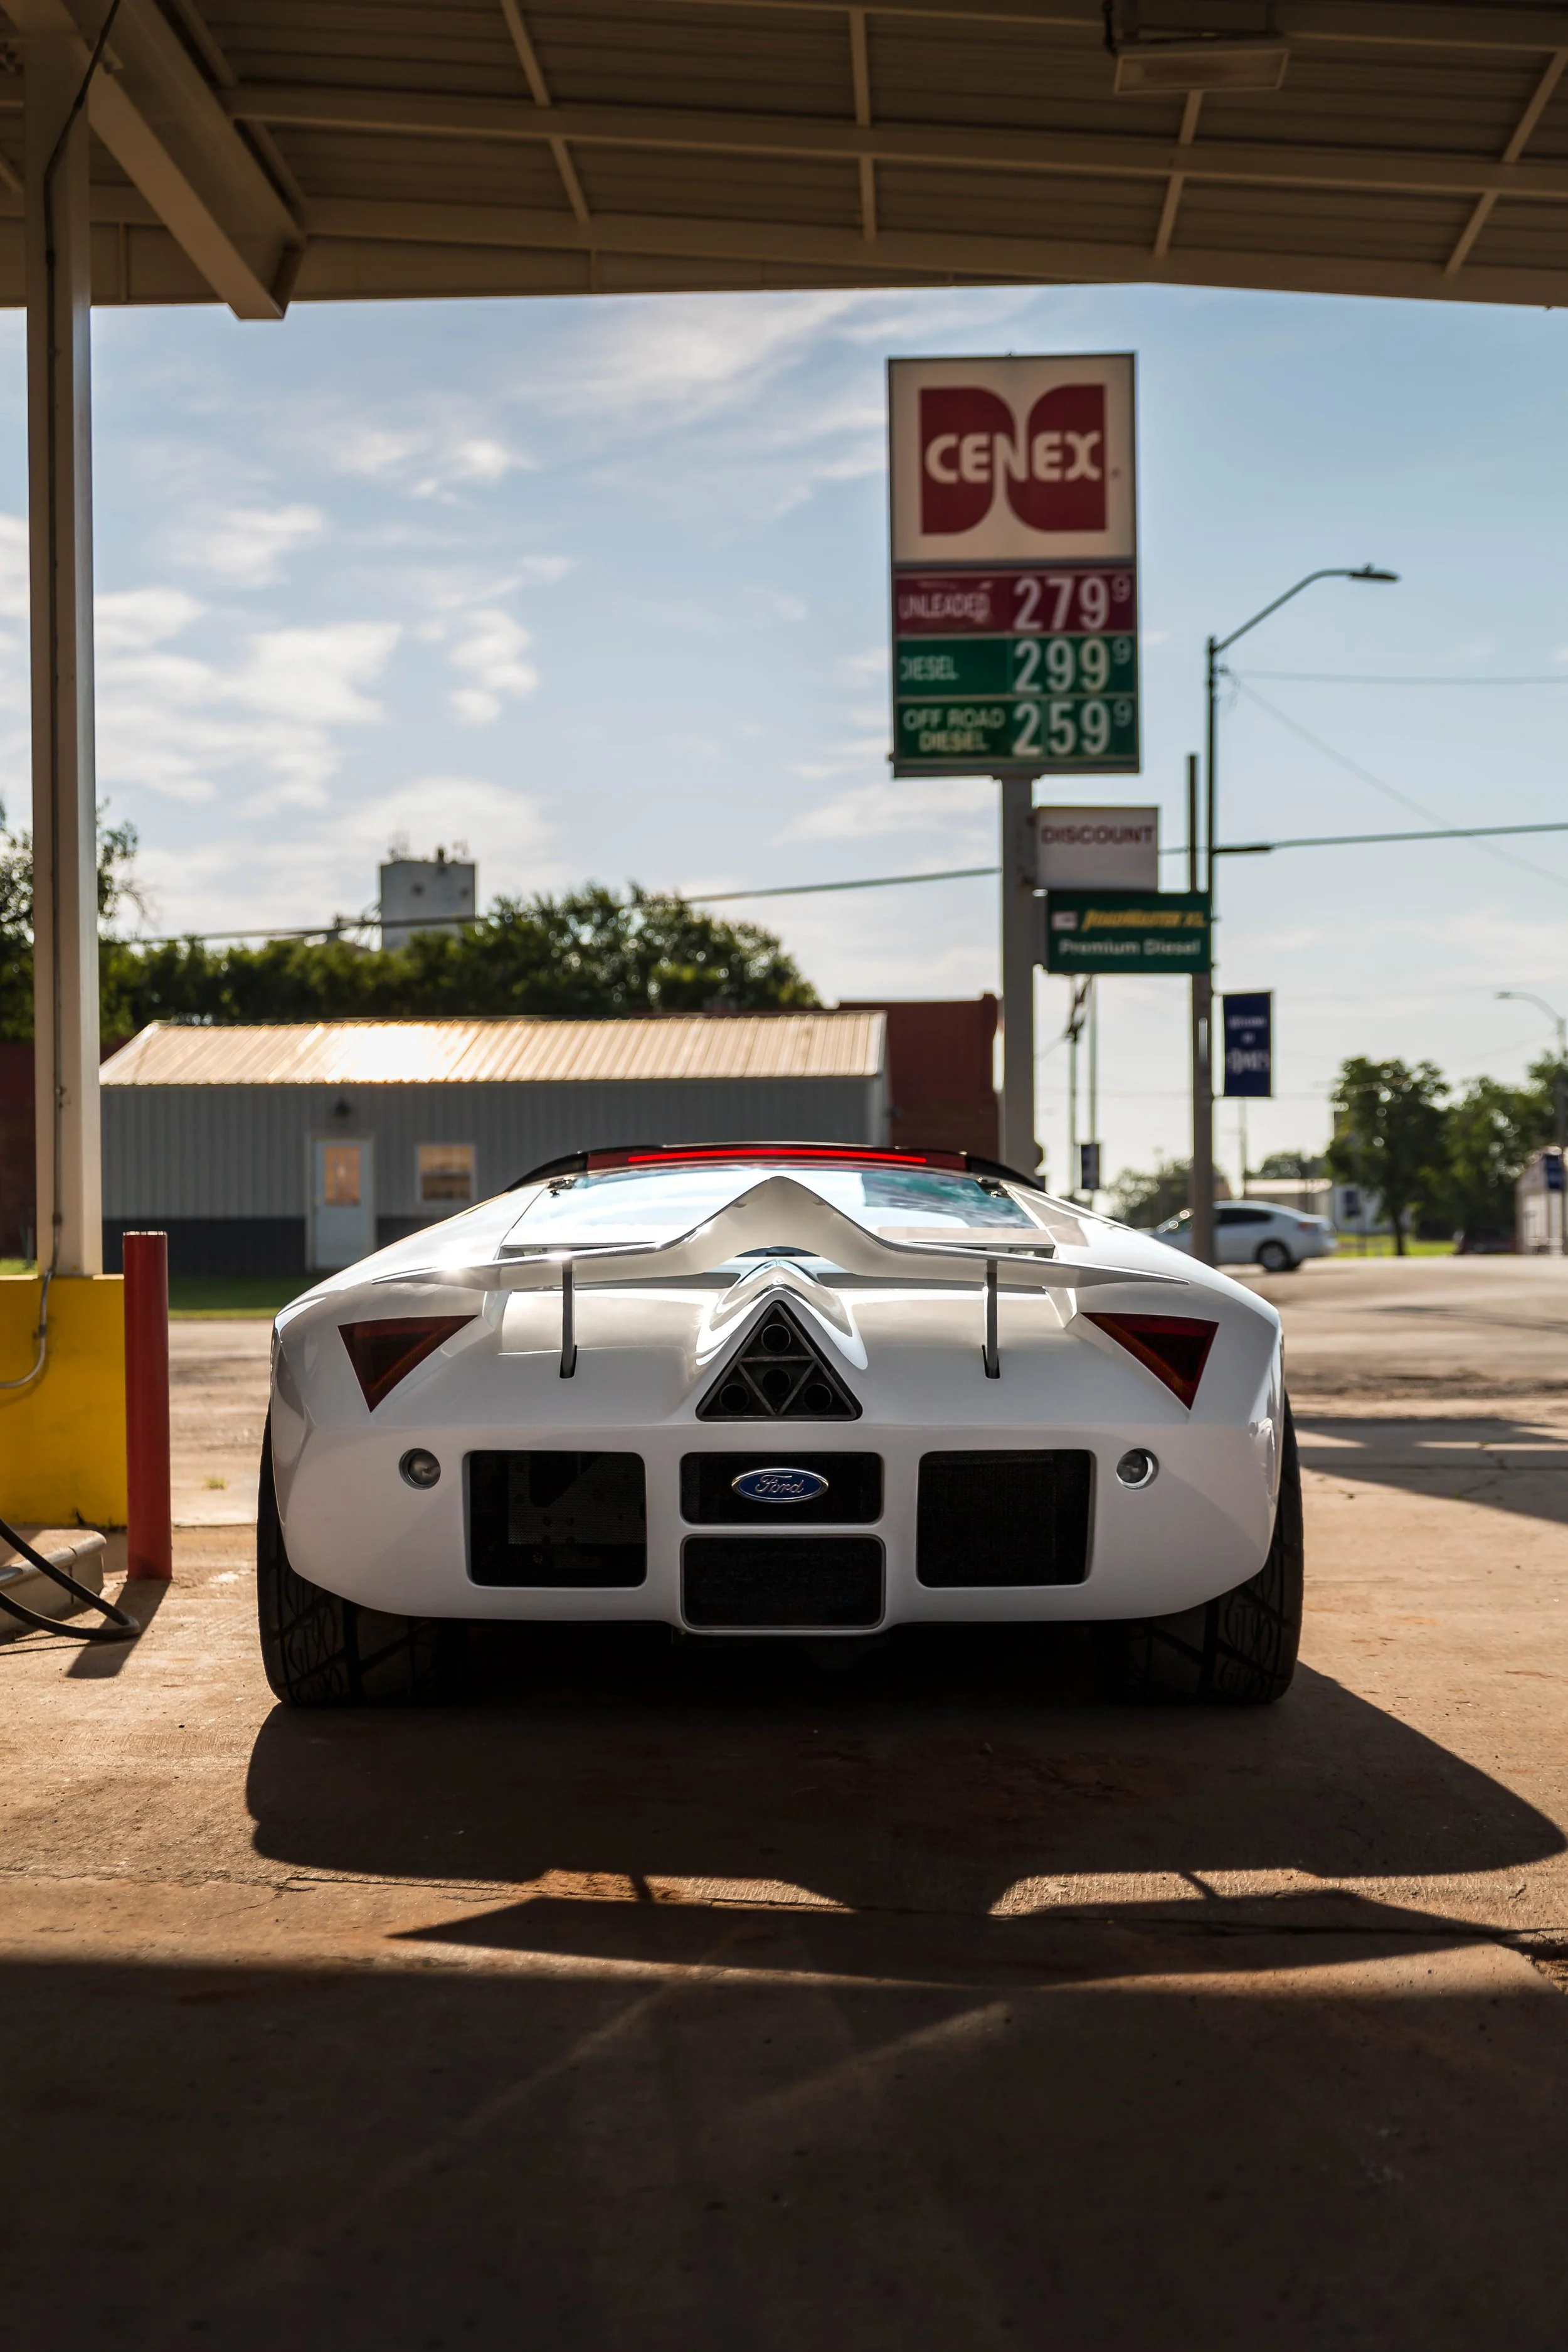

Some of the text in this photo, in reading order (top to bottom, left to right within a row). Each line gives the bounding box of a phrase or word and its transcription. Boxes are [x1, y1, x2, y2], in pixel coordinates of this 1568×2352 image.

[925, 430, 1101, 484] CENEX
[898, 592, 991, 620] UNLEADED
[1013, 576, 1110, 631] 279
[899, 655, 960, 681] DIESEL
[1014, 638, 1110, 694] 299
[903, 707, 943, 731] OFF
[947, 707, 1006, 729] ROAD
[1012, 700, 1111, 757] 259
[919, 730, 990, 752] DIESEL
[1041, 825, 1155, 846] DISCOUNT
[1058, 939, 1201, 956] Premium Diesel
[755, 1474, 805, 1494] Ford
